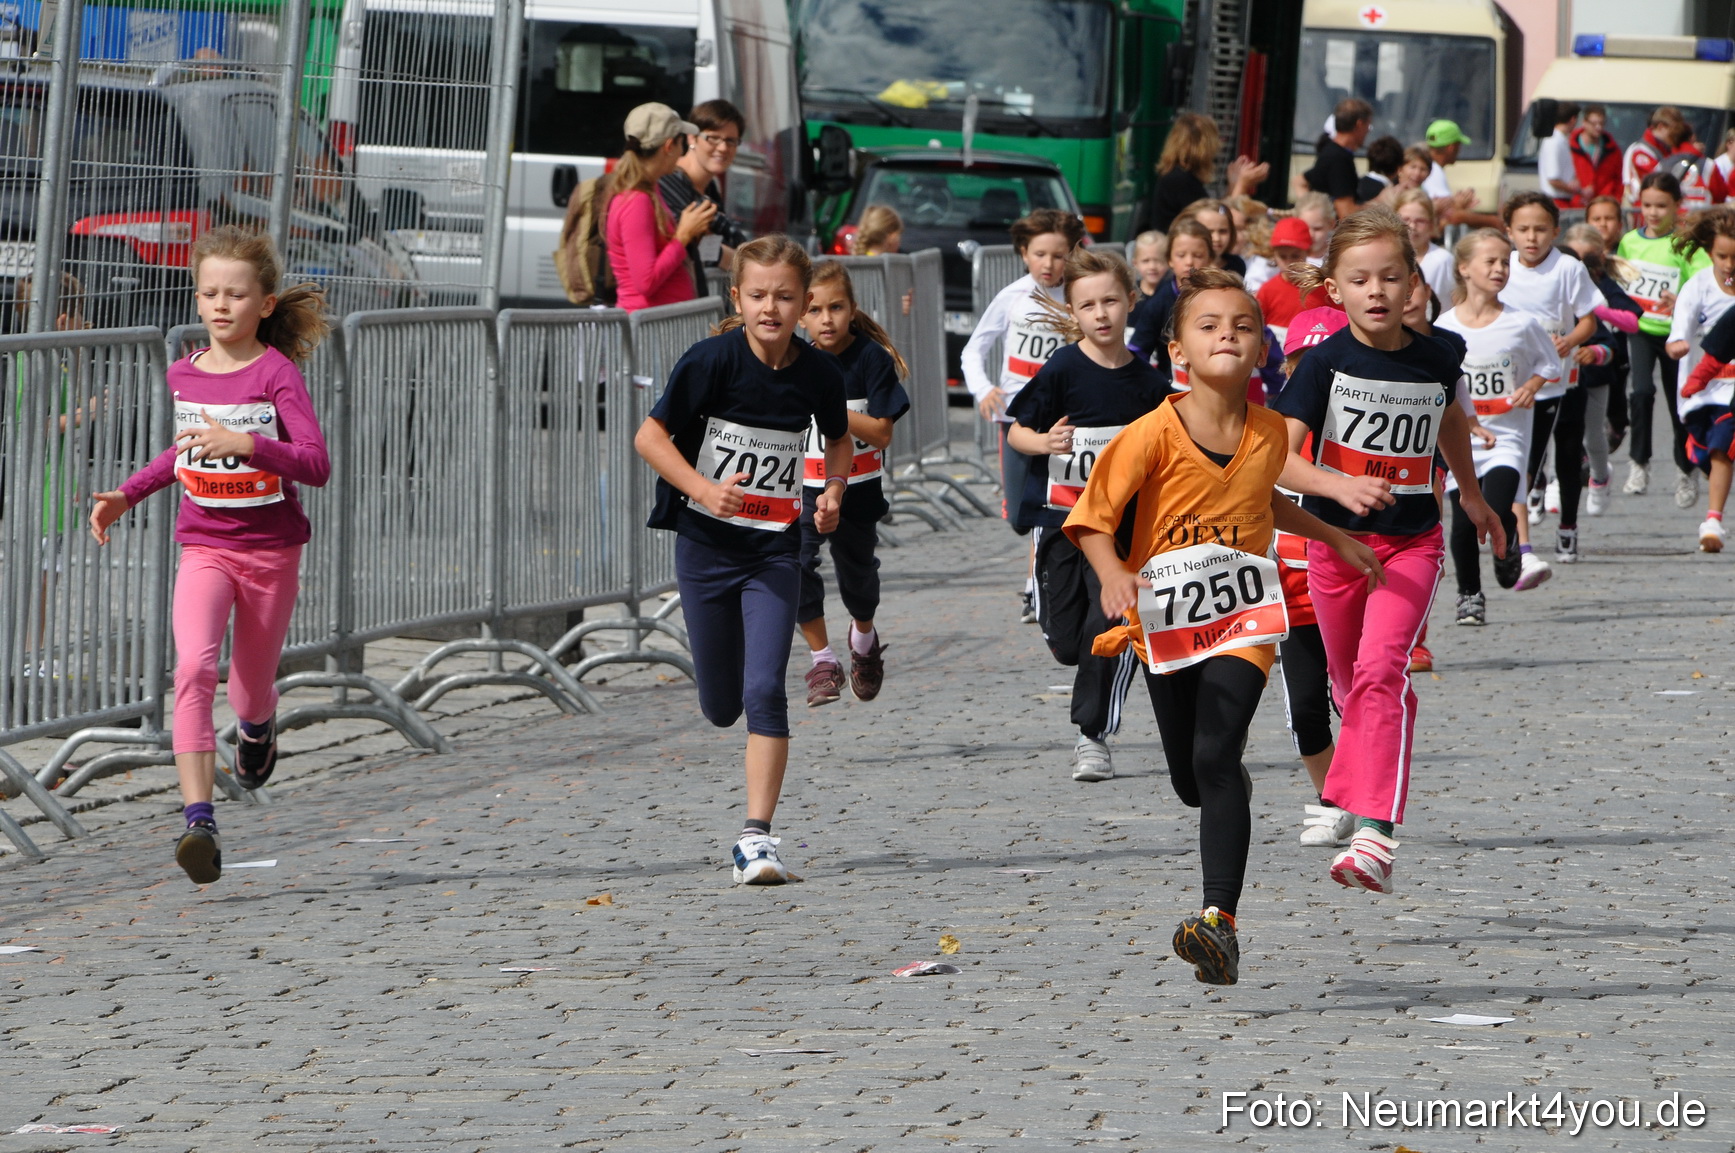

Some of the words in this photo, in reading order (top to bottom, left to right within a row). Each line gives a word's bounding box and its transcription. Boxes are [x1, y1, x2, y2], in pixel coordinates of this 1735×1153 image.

[1626, 276, 1670, 299] 278
[1017, 331, 1066, 360] 702
[1334, 384, 1377, 403] PARTL
[1380, 393, 1431, 406] Neumarkt
[708, 427, 746, 446] PARTL
[749, 438, 797, 452] Neumarkt
[1341, 406, 1432, 454] 7200
[713, 445, 798, 492] 7024
[1365, 460, 1397, 480] Mia
[195, 476, 255, 494] Theresa
[739, 501, 770, 516] ucia
[1203, 515, 1229, 523] UHREN
[1141, 565, 1182, 581] PARTL
[1184, 550, 1249, 573] Neumarkt
[1154, 565, 1265, 627] 7250
[1192, 622, 1243, 651] Alicia
